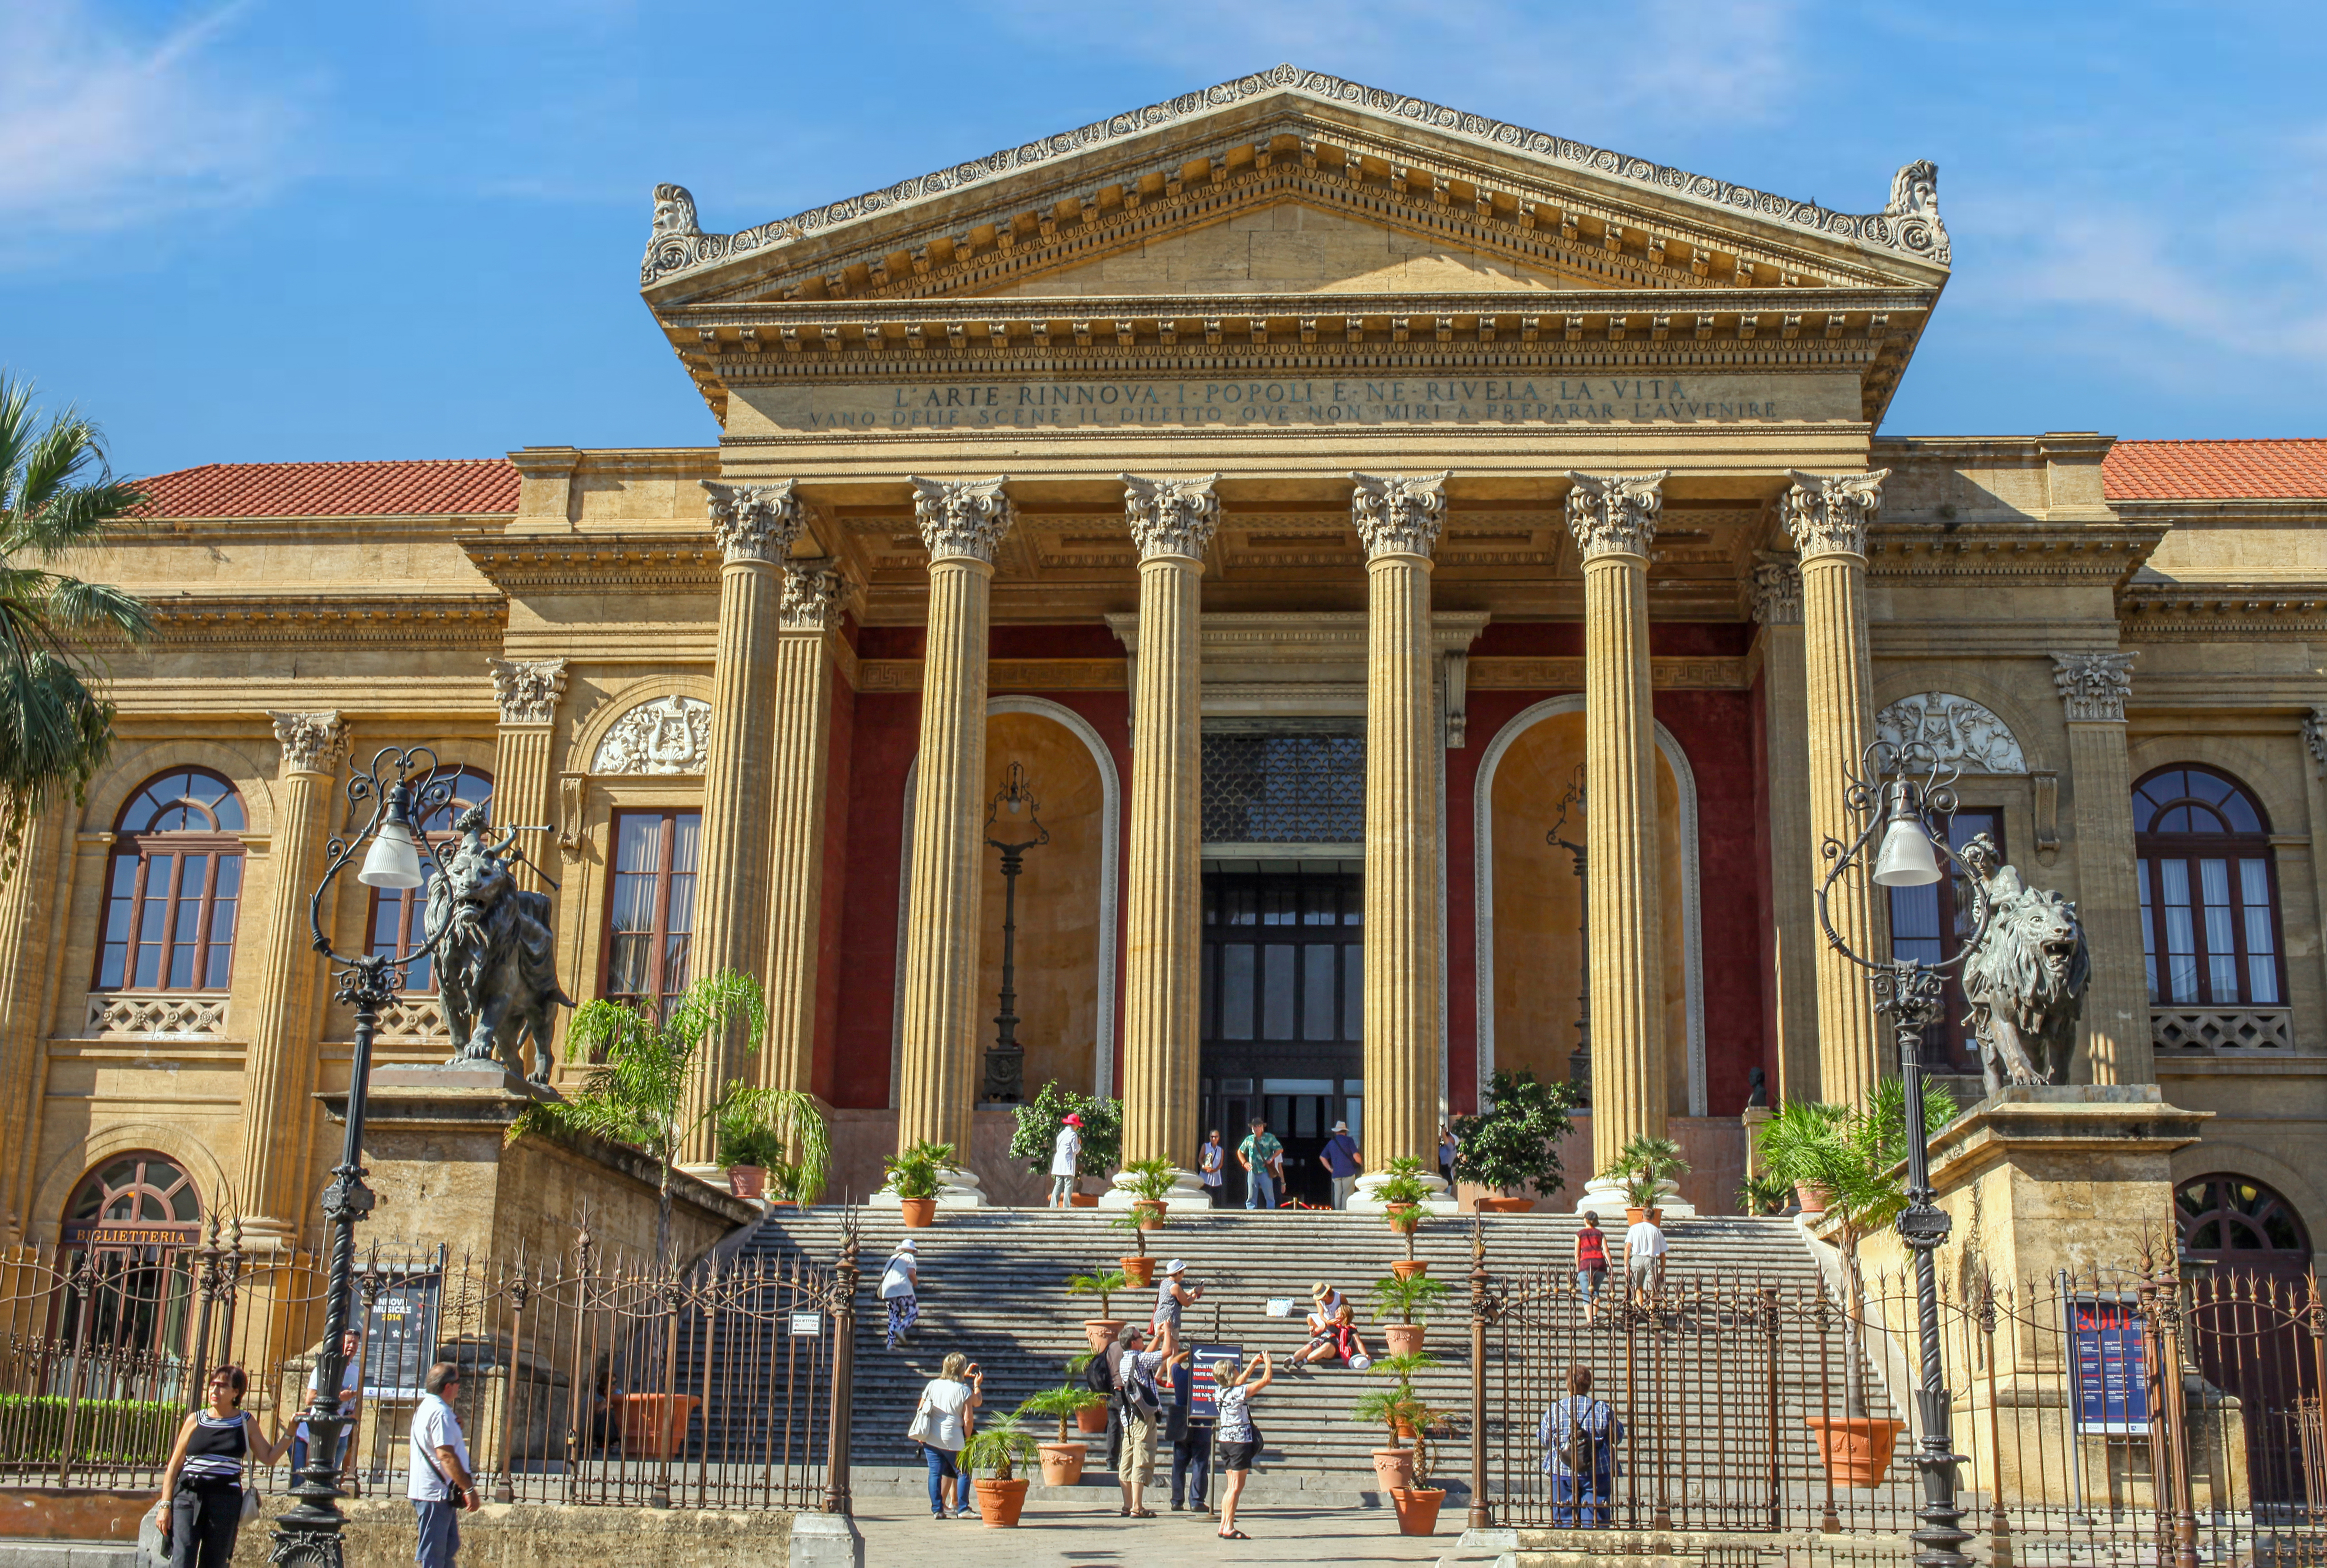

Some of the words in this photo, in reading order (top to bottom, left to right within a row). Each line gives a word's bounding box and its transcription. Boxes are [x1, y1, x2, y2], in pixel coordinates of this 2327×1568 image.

[895, 387, 999, 407] L'ARTE
[1019, 385, 1159, 405] RINNOVA
[1178, 384, 1184, 403] I
[1206, 382, 1312, 403] POPOLI
[1333, 382, 1346, 402] E
[1365, 381, 1405, 401] NE
[1426, 381, 1538, 401] RIVELA
[1561, 380, 1594, 400] LA
[1611, 380, 1686, 399] VITA
[811, 411, 875, 426] VANO
[893, 409, 959, 426] DELLE
[979, 408, 1061, 425] SCENE
[1080, 408, 1103, 423] IL
[1120, 407, 1221, 422] DILETTO
[1242, 405, 1289, 421] OVE
[1309, 405, 1360, 420] NON
[1385, 404, 1439, 419] MIRI
[1457, 404, 1469, 419] A
[1487, 403, 1616, 419] PREPARAR
[1635, 402, 1776, 418] L'AVVENIRE
[77, 1230, 186, 1243] BIGLIETTERIA
[2074, 1308, 2131, 1330] 2014
